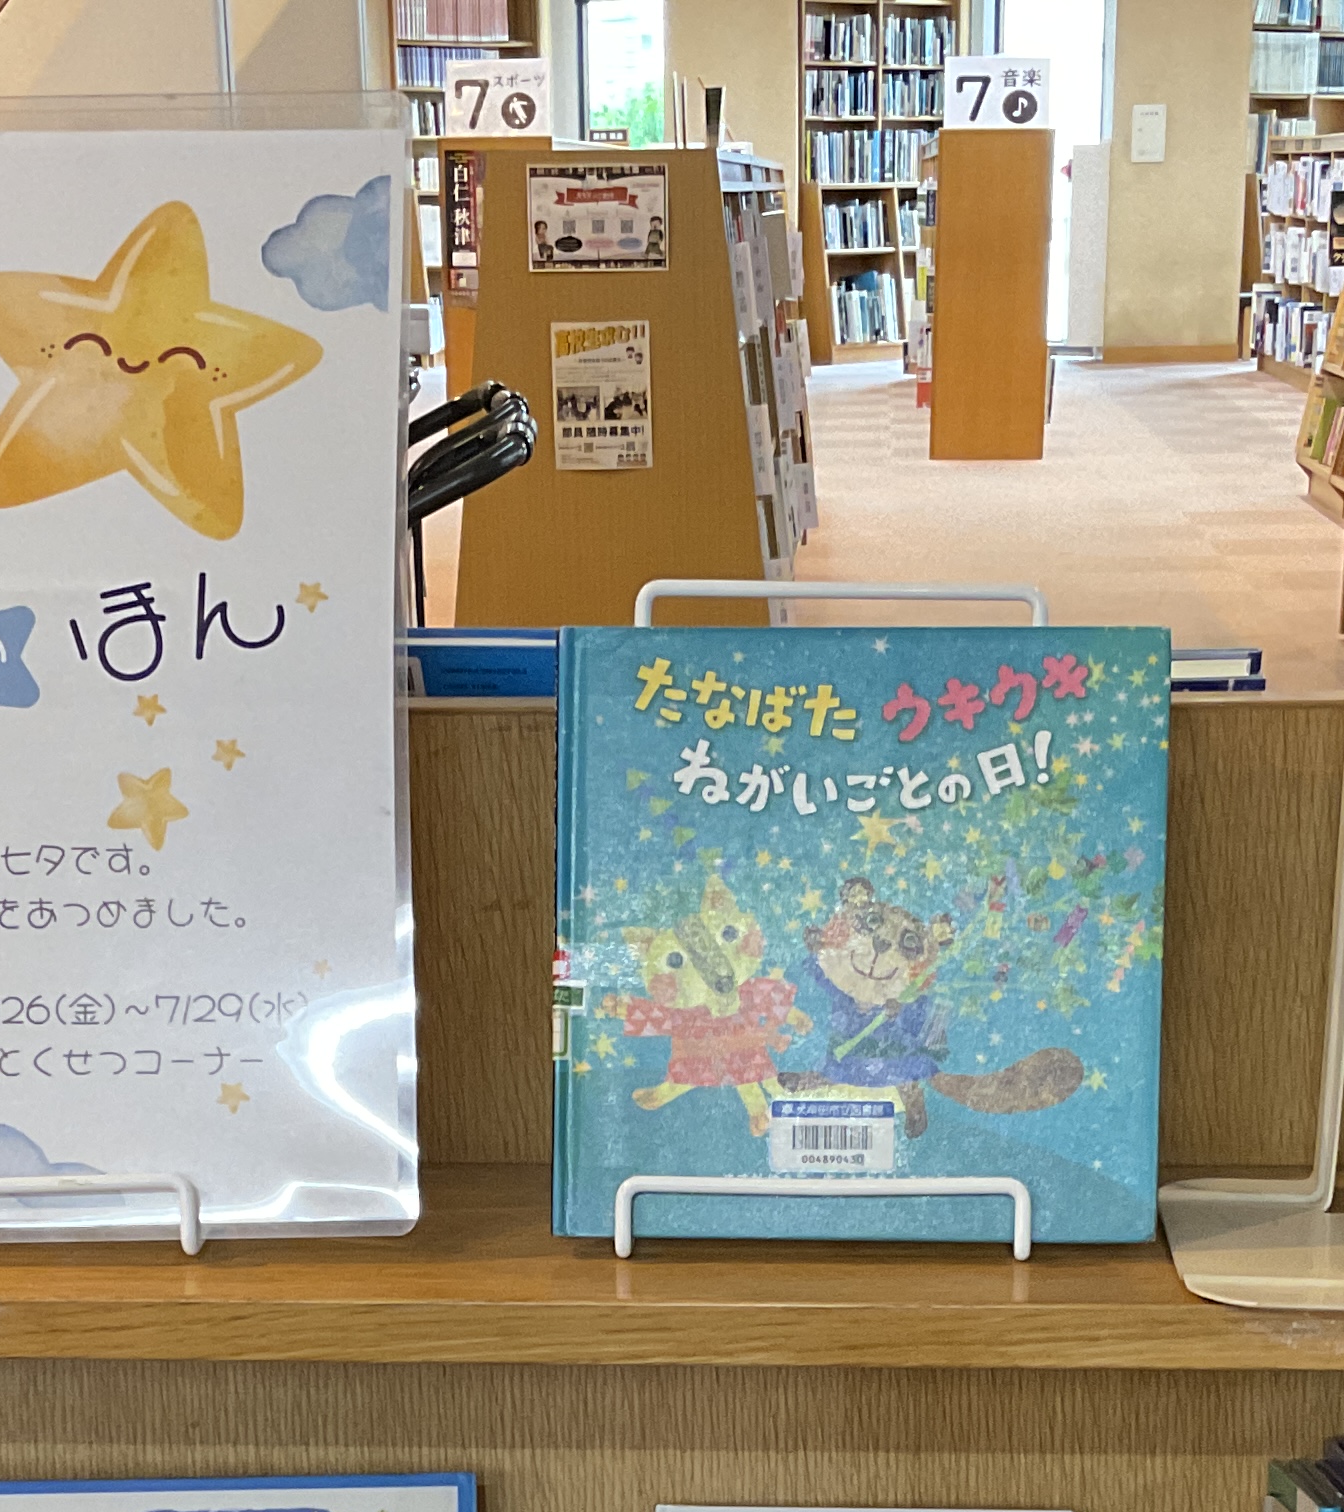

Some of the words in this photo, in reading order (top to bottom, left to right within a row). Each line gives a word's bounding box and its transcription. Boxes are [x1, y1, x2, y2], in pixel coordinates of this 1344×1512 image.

[493, 75, 545, 88] スポーツ
[956, 75, 991, 122] 7
[1000, 67, 1041, 88] 音楽
[455, 79, 490, 129] 7
[635, 656, 858, 741] たなばた
[882, 654, 1091, 742] ウキウキ
